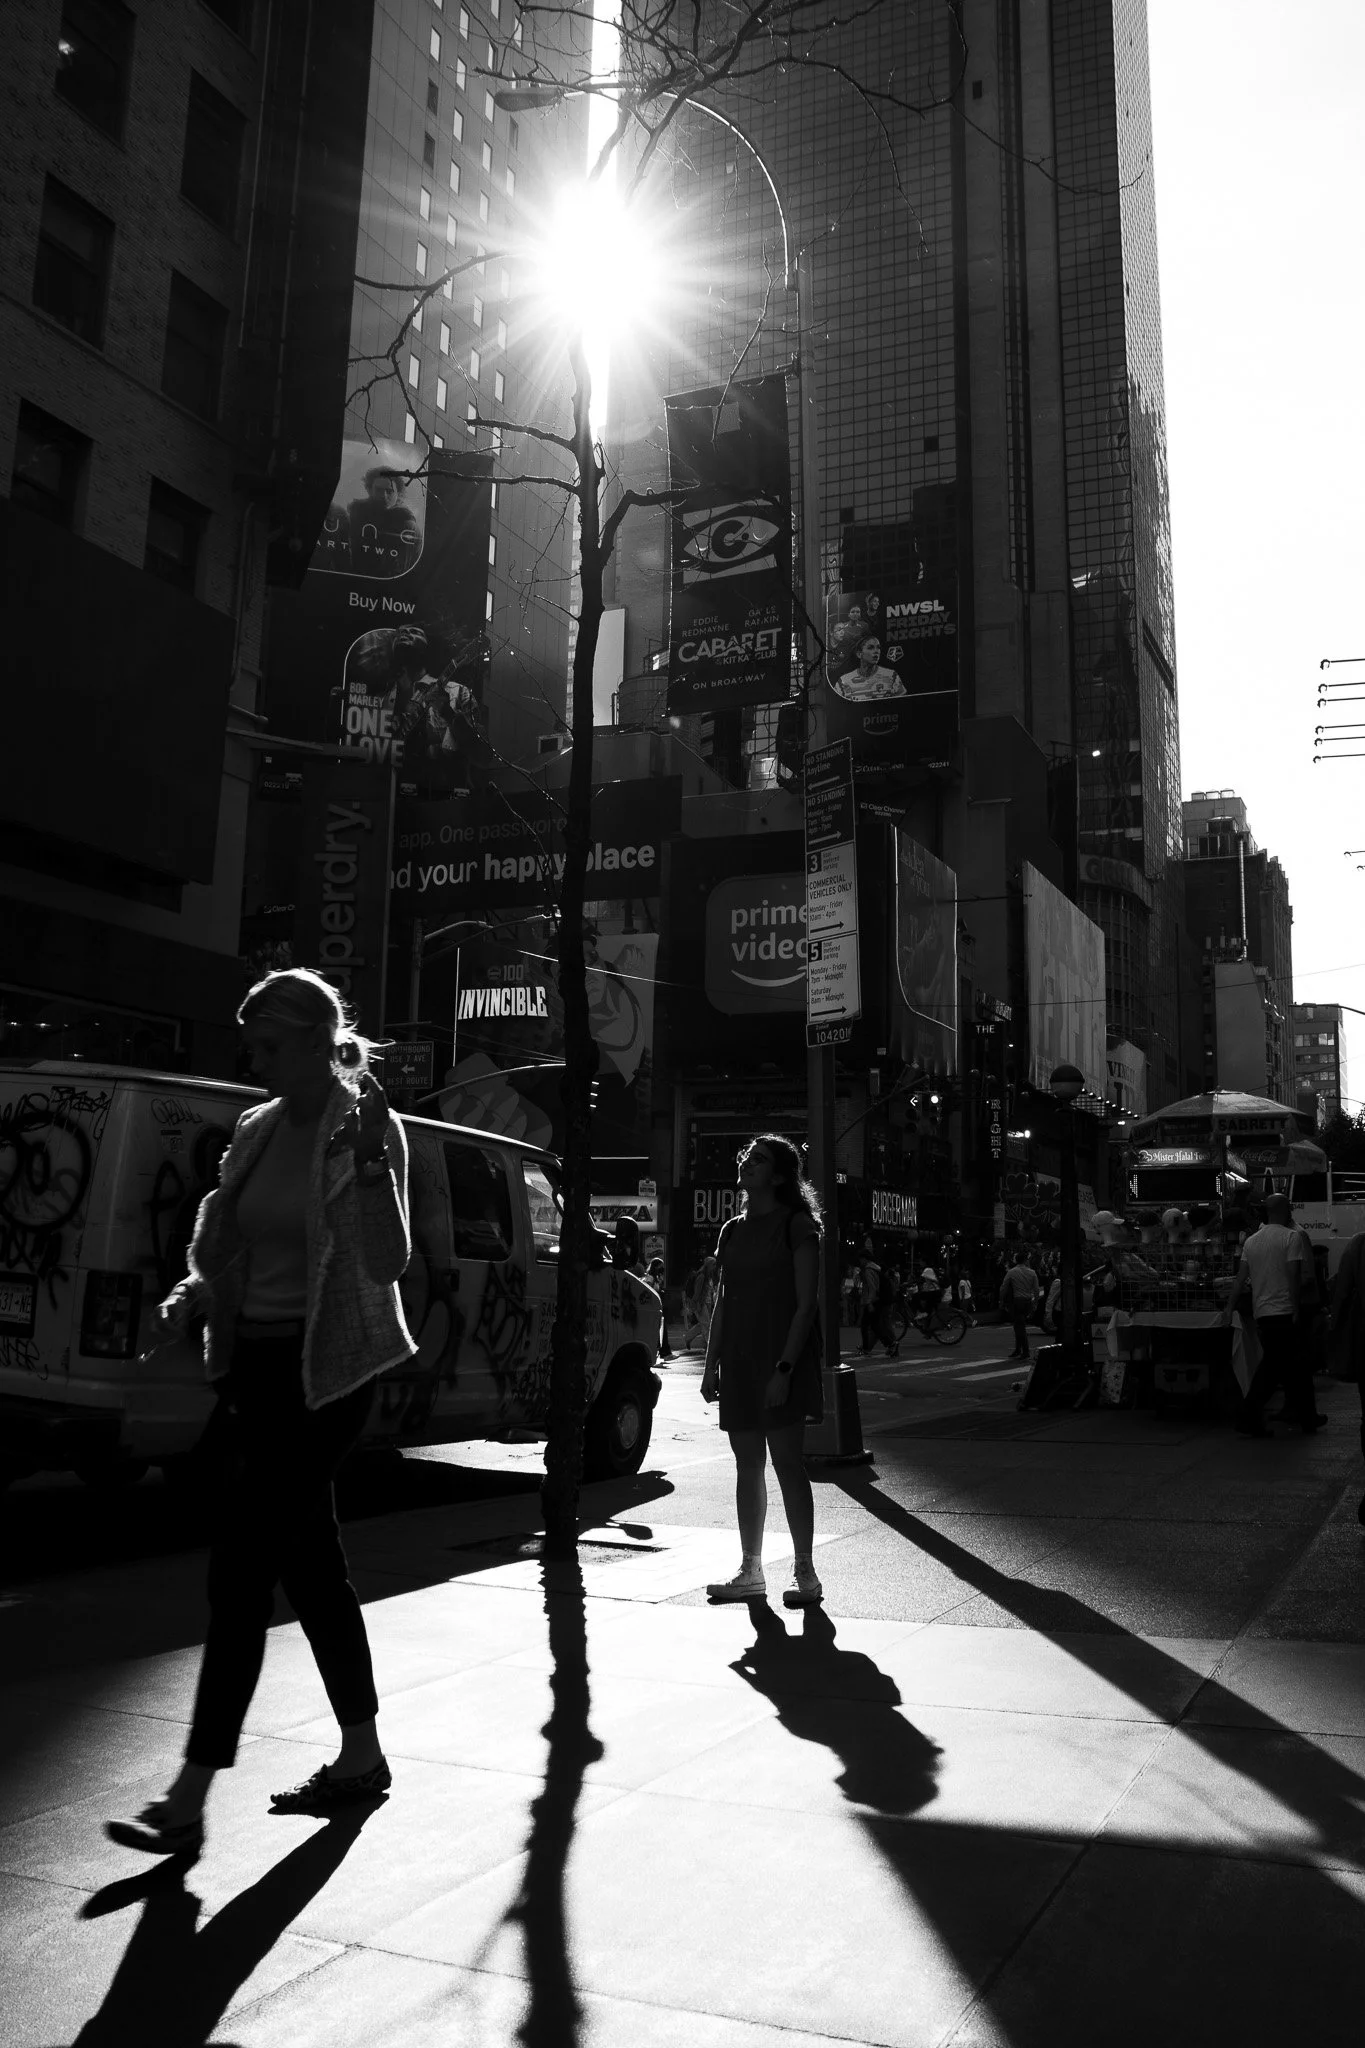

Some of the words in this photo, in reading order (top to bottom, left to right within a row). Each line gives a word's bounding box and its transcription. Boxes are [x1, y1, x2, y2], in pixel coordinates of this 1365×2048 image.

[362, 544, 399, 557] TWO
[348, 591, 378, 612] Buy
[382, 596, 416, 615] Now
[748, 604, 777, 617] GALE
[886, 599, 945, 619] NWSL
[693, 615, 719, 627] EDDIE
[886, 611, 951, 630] FRIDAY
[681, 623, 730, 638] REDMAYNE
[886, 623, 957, 642] NIGHTS
[678, 627, 783, 663] CABARET
[350, 682, 367, 694] BOB
[692, 681, 707, 690] ON
[349, 694, 385, 708] MARLEY
[346, 705, 395, 738] ONE
[863, 712, 899, 727] prime
[806, 755, 815, 766] NO
[816, 744, 845, 763] STANDING
[807, 797, 816, 807] NO
[817, 787, 846, 805] STANDING
[439, 824, 474, 844] One
[810, 854, 818, 872] 3
[417, 860, 478, 893] your
[484, 851, 567, 884] happy
[809, 873, 846, 890] COMMERCIAL
[809, 886, 837, 900] VEHICLES
[837, 881, 853, 893] ONLY
[809, 904, 826, 913] Monday
[829, 900, 844, 909] Friday
[826, 910, 837, 919] 4pm
[810, 942, 819, 961] 5
[503, 963, 524, 982] 100
[810, 966, 828, 976] Monday
[832, 962, 848, 972] Friday
[824, 971, 844, 981] Midnight
[811, 987, 832, 996] Saturday
[825, 993, 845, 1002] Midnight
[457, 986, 549, 1021] INVINCIBLE
[975, 1024, 996, 1035] THE
[414, 1054, 426, 1062] AVE
[386, 1077, 403, 1086] BEST
[406, 1076, 429, 1085] ROUTE
[990, 1099, 1002, 1159] RIGHT
[1152, 1151, 1174, 1162] Mister
[1175, 1150, 1193, 1163] Halal
[589, 1205, 653, 1222] PIZZA
